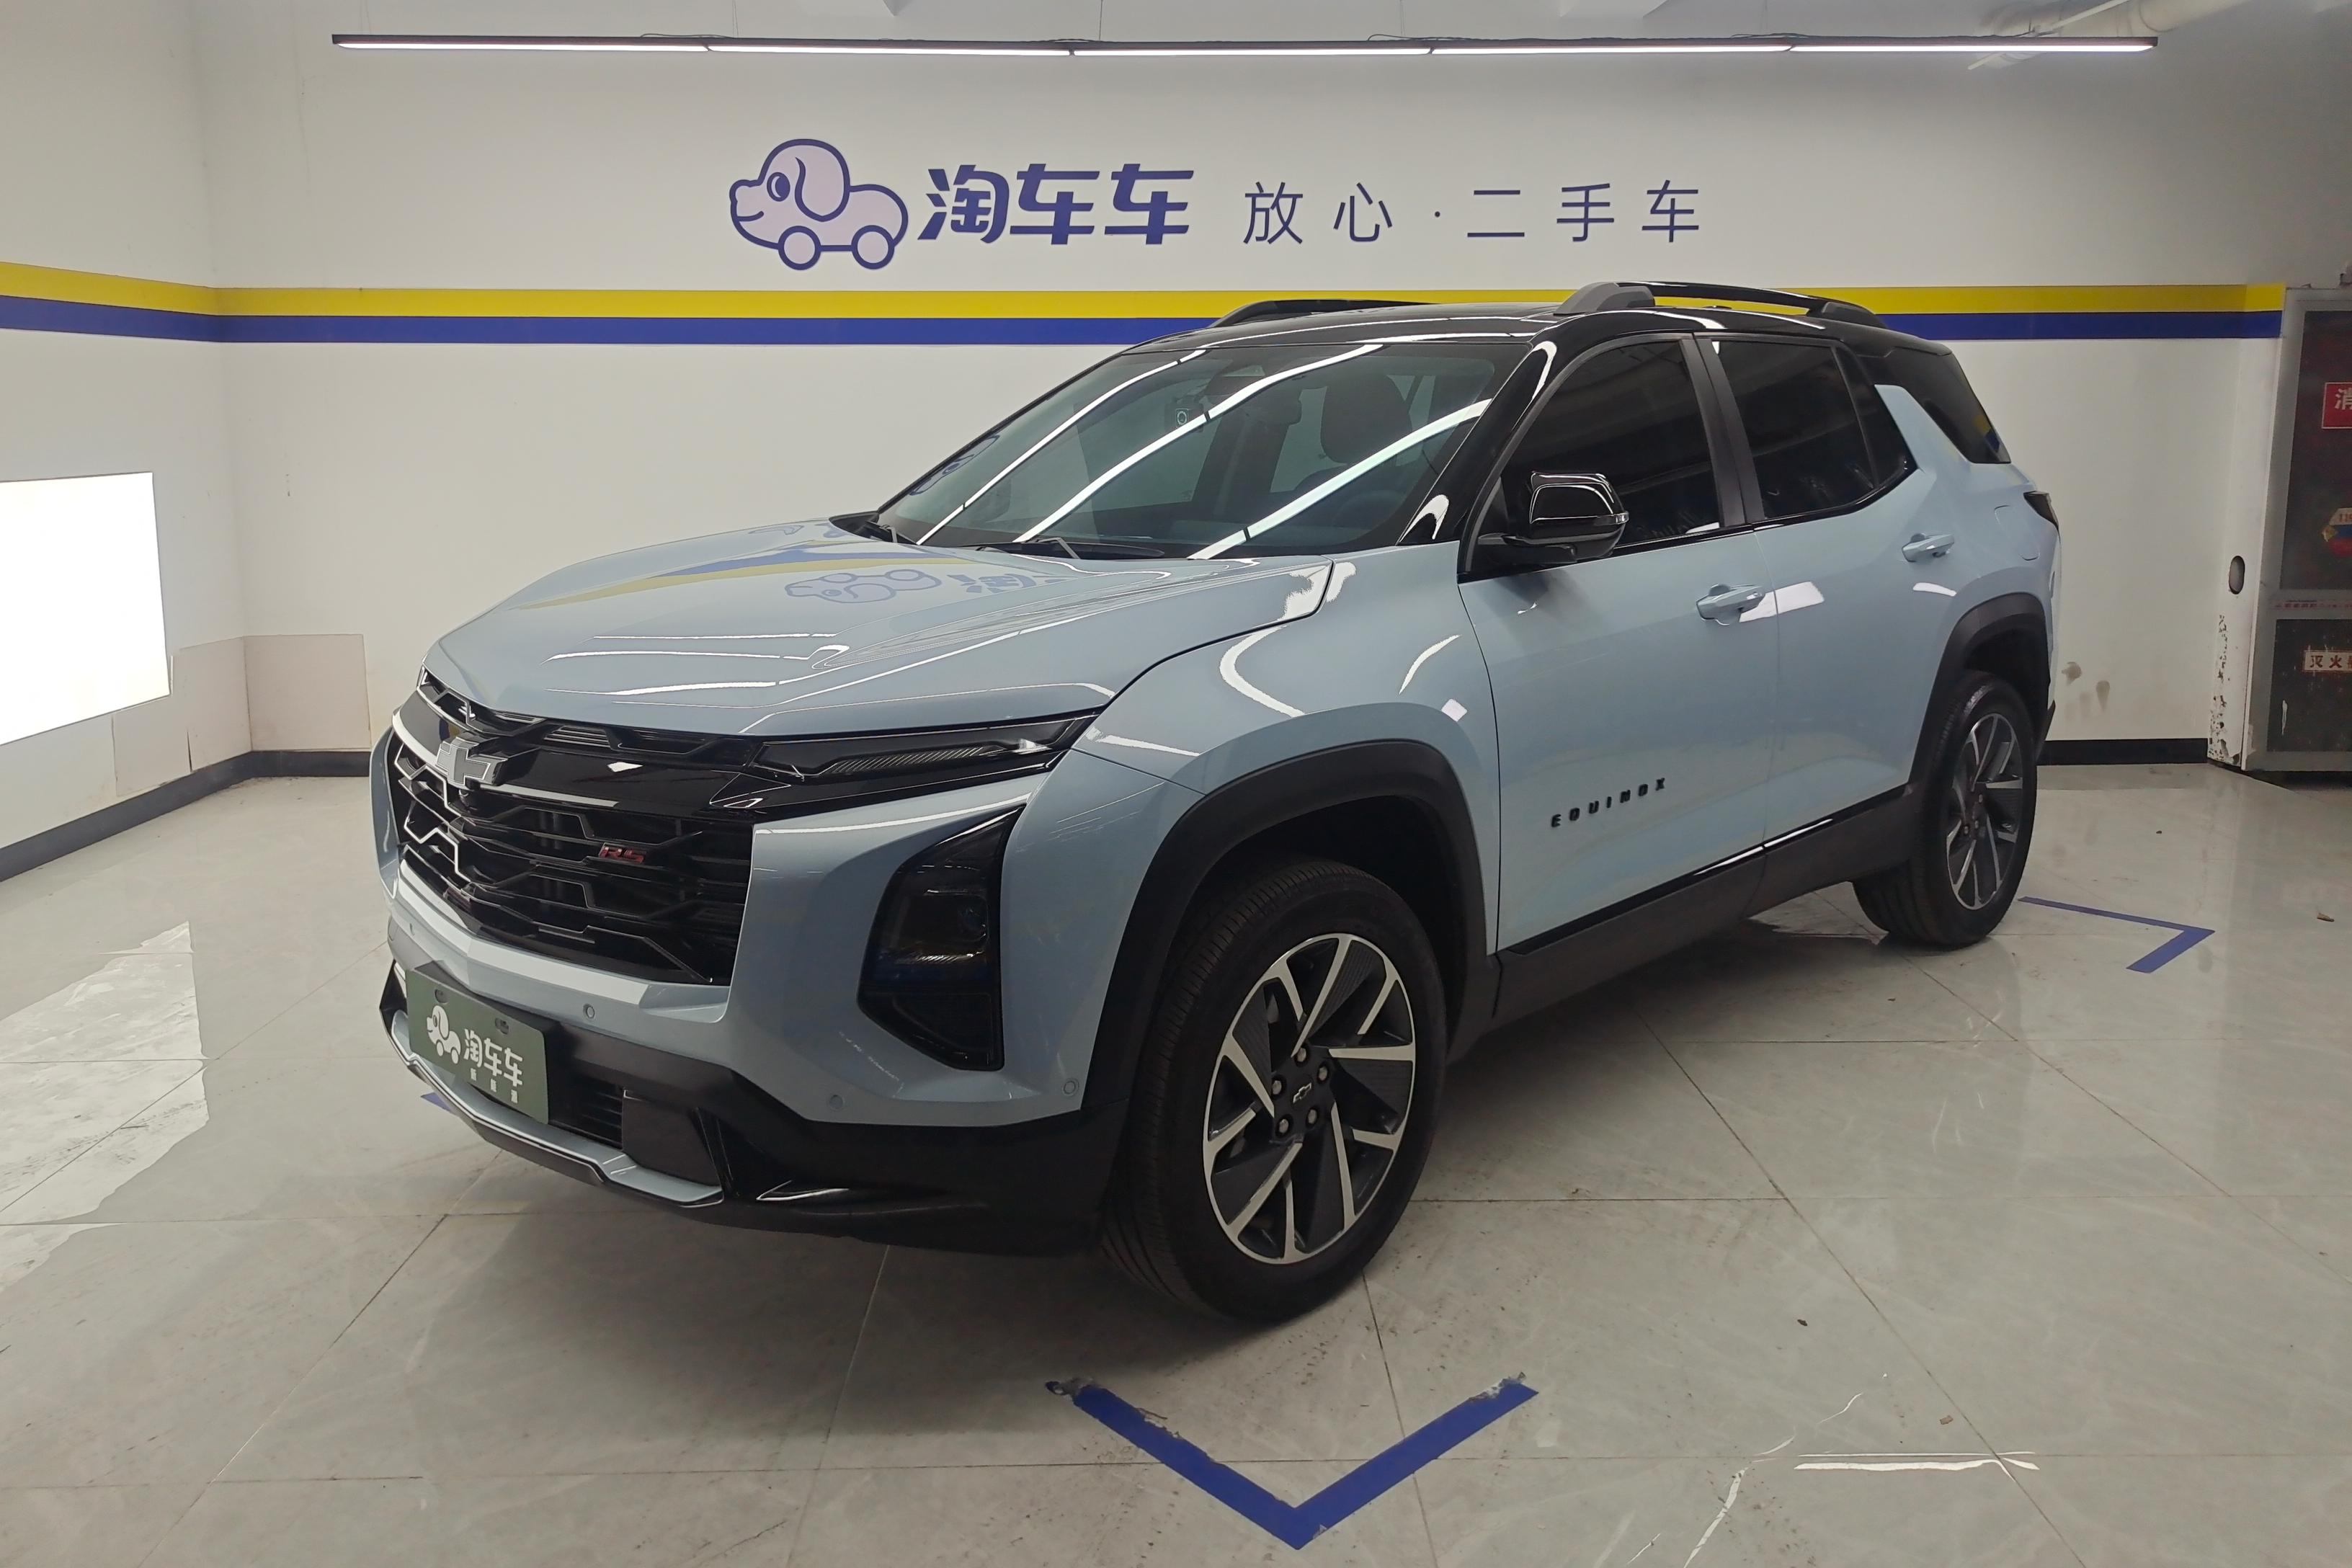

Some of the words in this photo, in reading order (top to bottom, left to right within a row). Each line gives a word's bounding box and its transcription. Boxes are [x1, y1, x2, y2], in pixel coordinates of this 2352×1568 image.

[918, 164, 1194, 245] 淘车车
[464, 1028, 522, 1087] 淘车车
